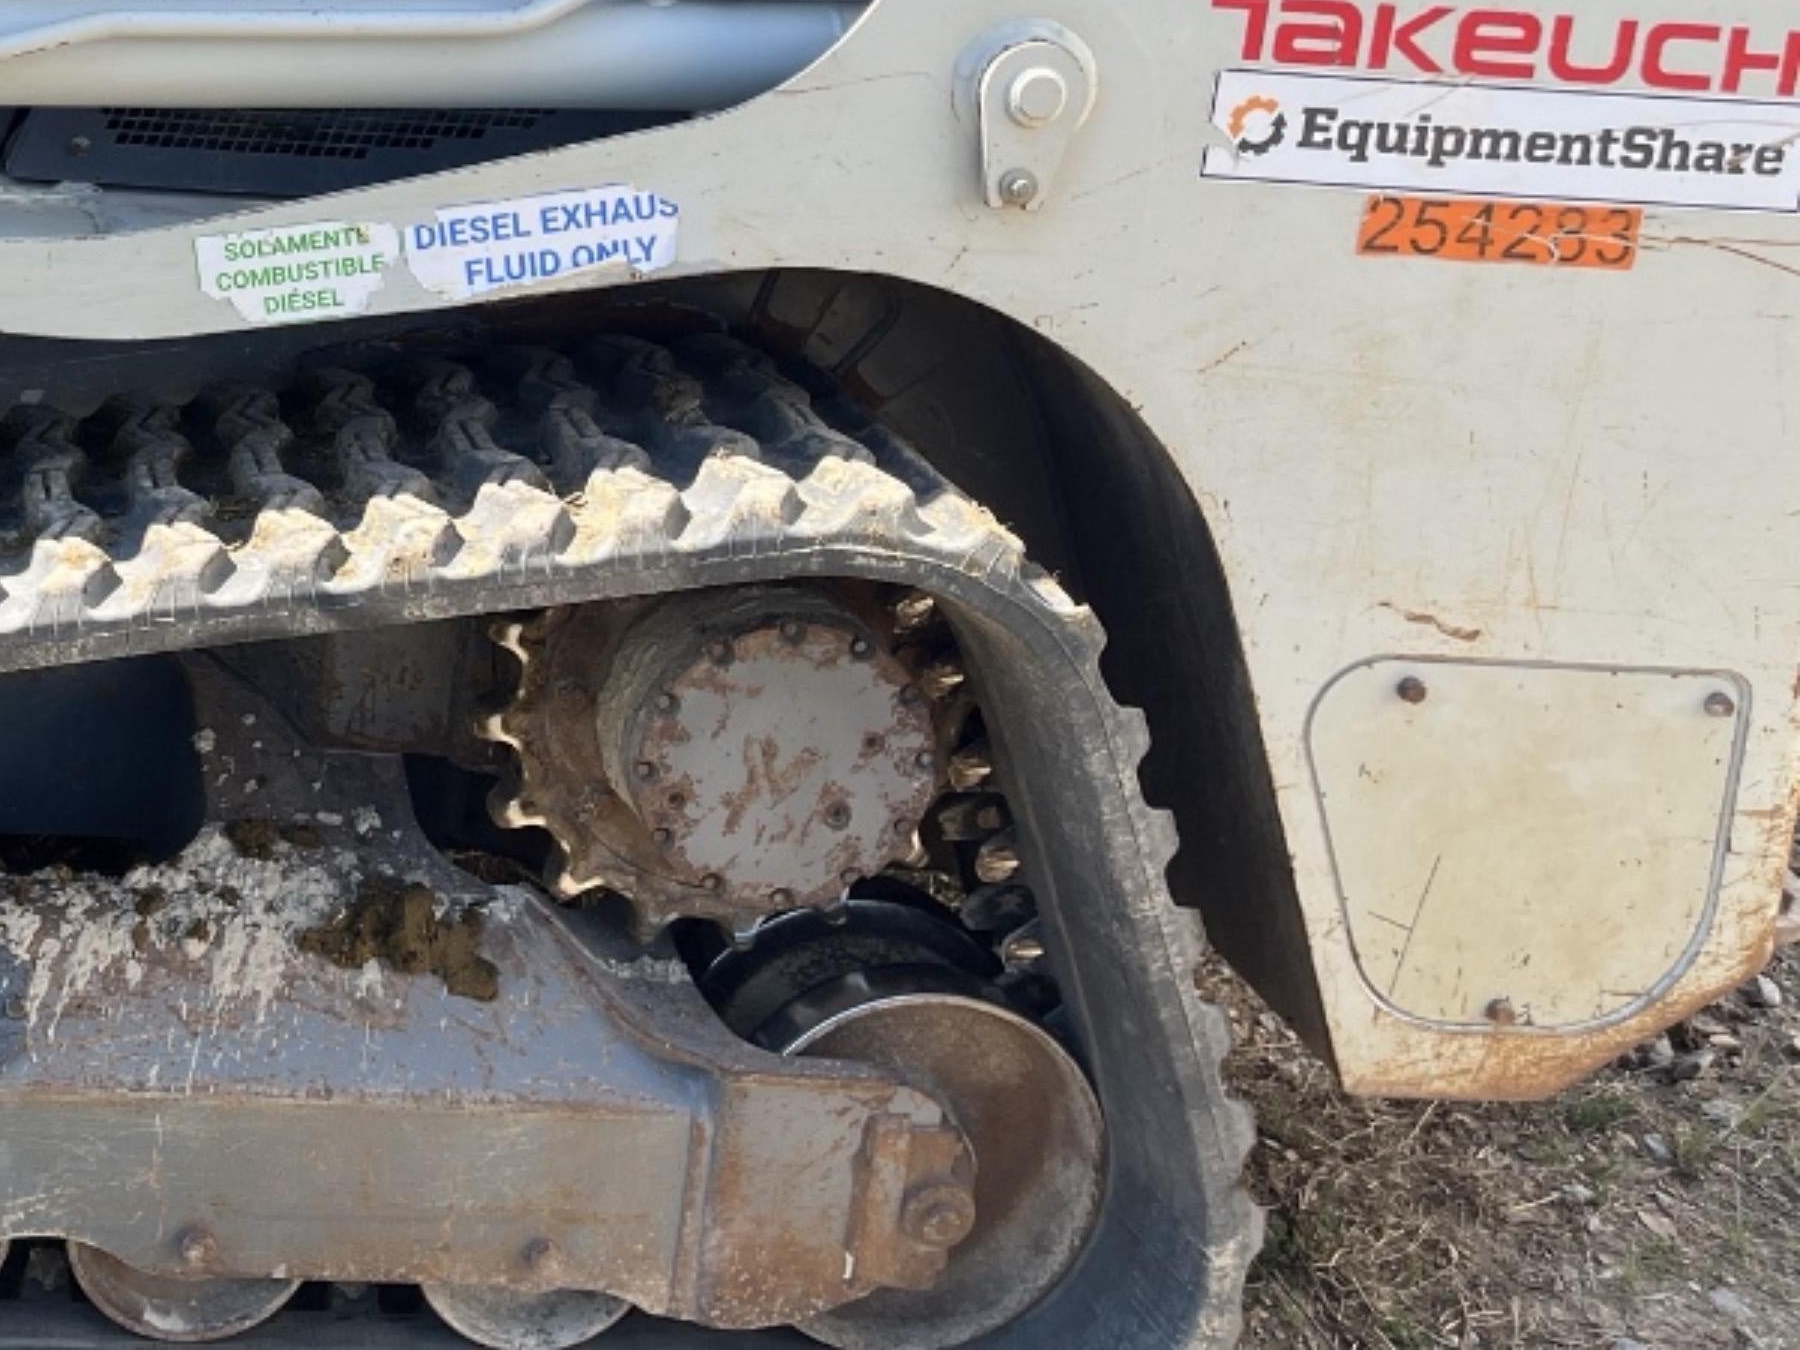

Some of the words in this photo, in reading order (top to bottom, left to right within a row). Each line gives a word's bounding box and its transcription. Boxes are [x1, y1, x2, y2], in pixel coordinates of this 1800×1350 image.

[1296, 106, 1785, 176] EquipmentShare
[413, 212, 532, 250] DIESEL
[215, 253, 386, 292] COMBUSTIBLE
[464, 249, 562, 286] FLUID
[263, 287, 346, 315] DIÉSEL
